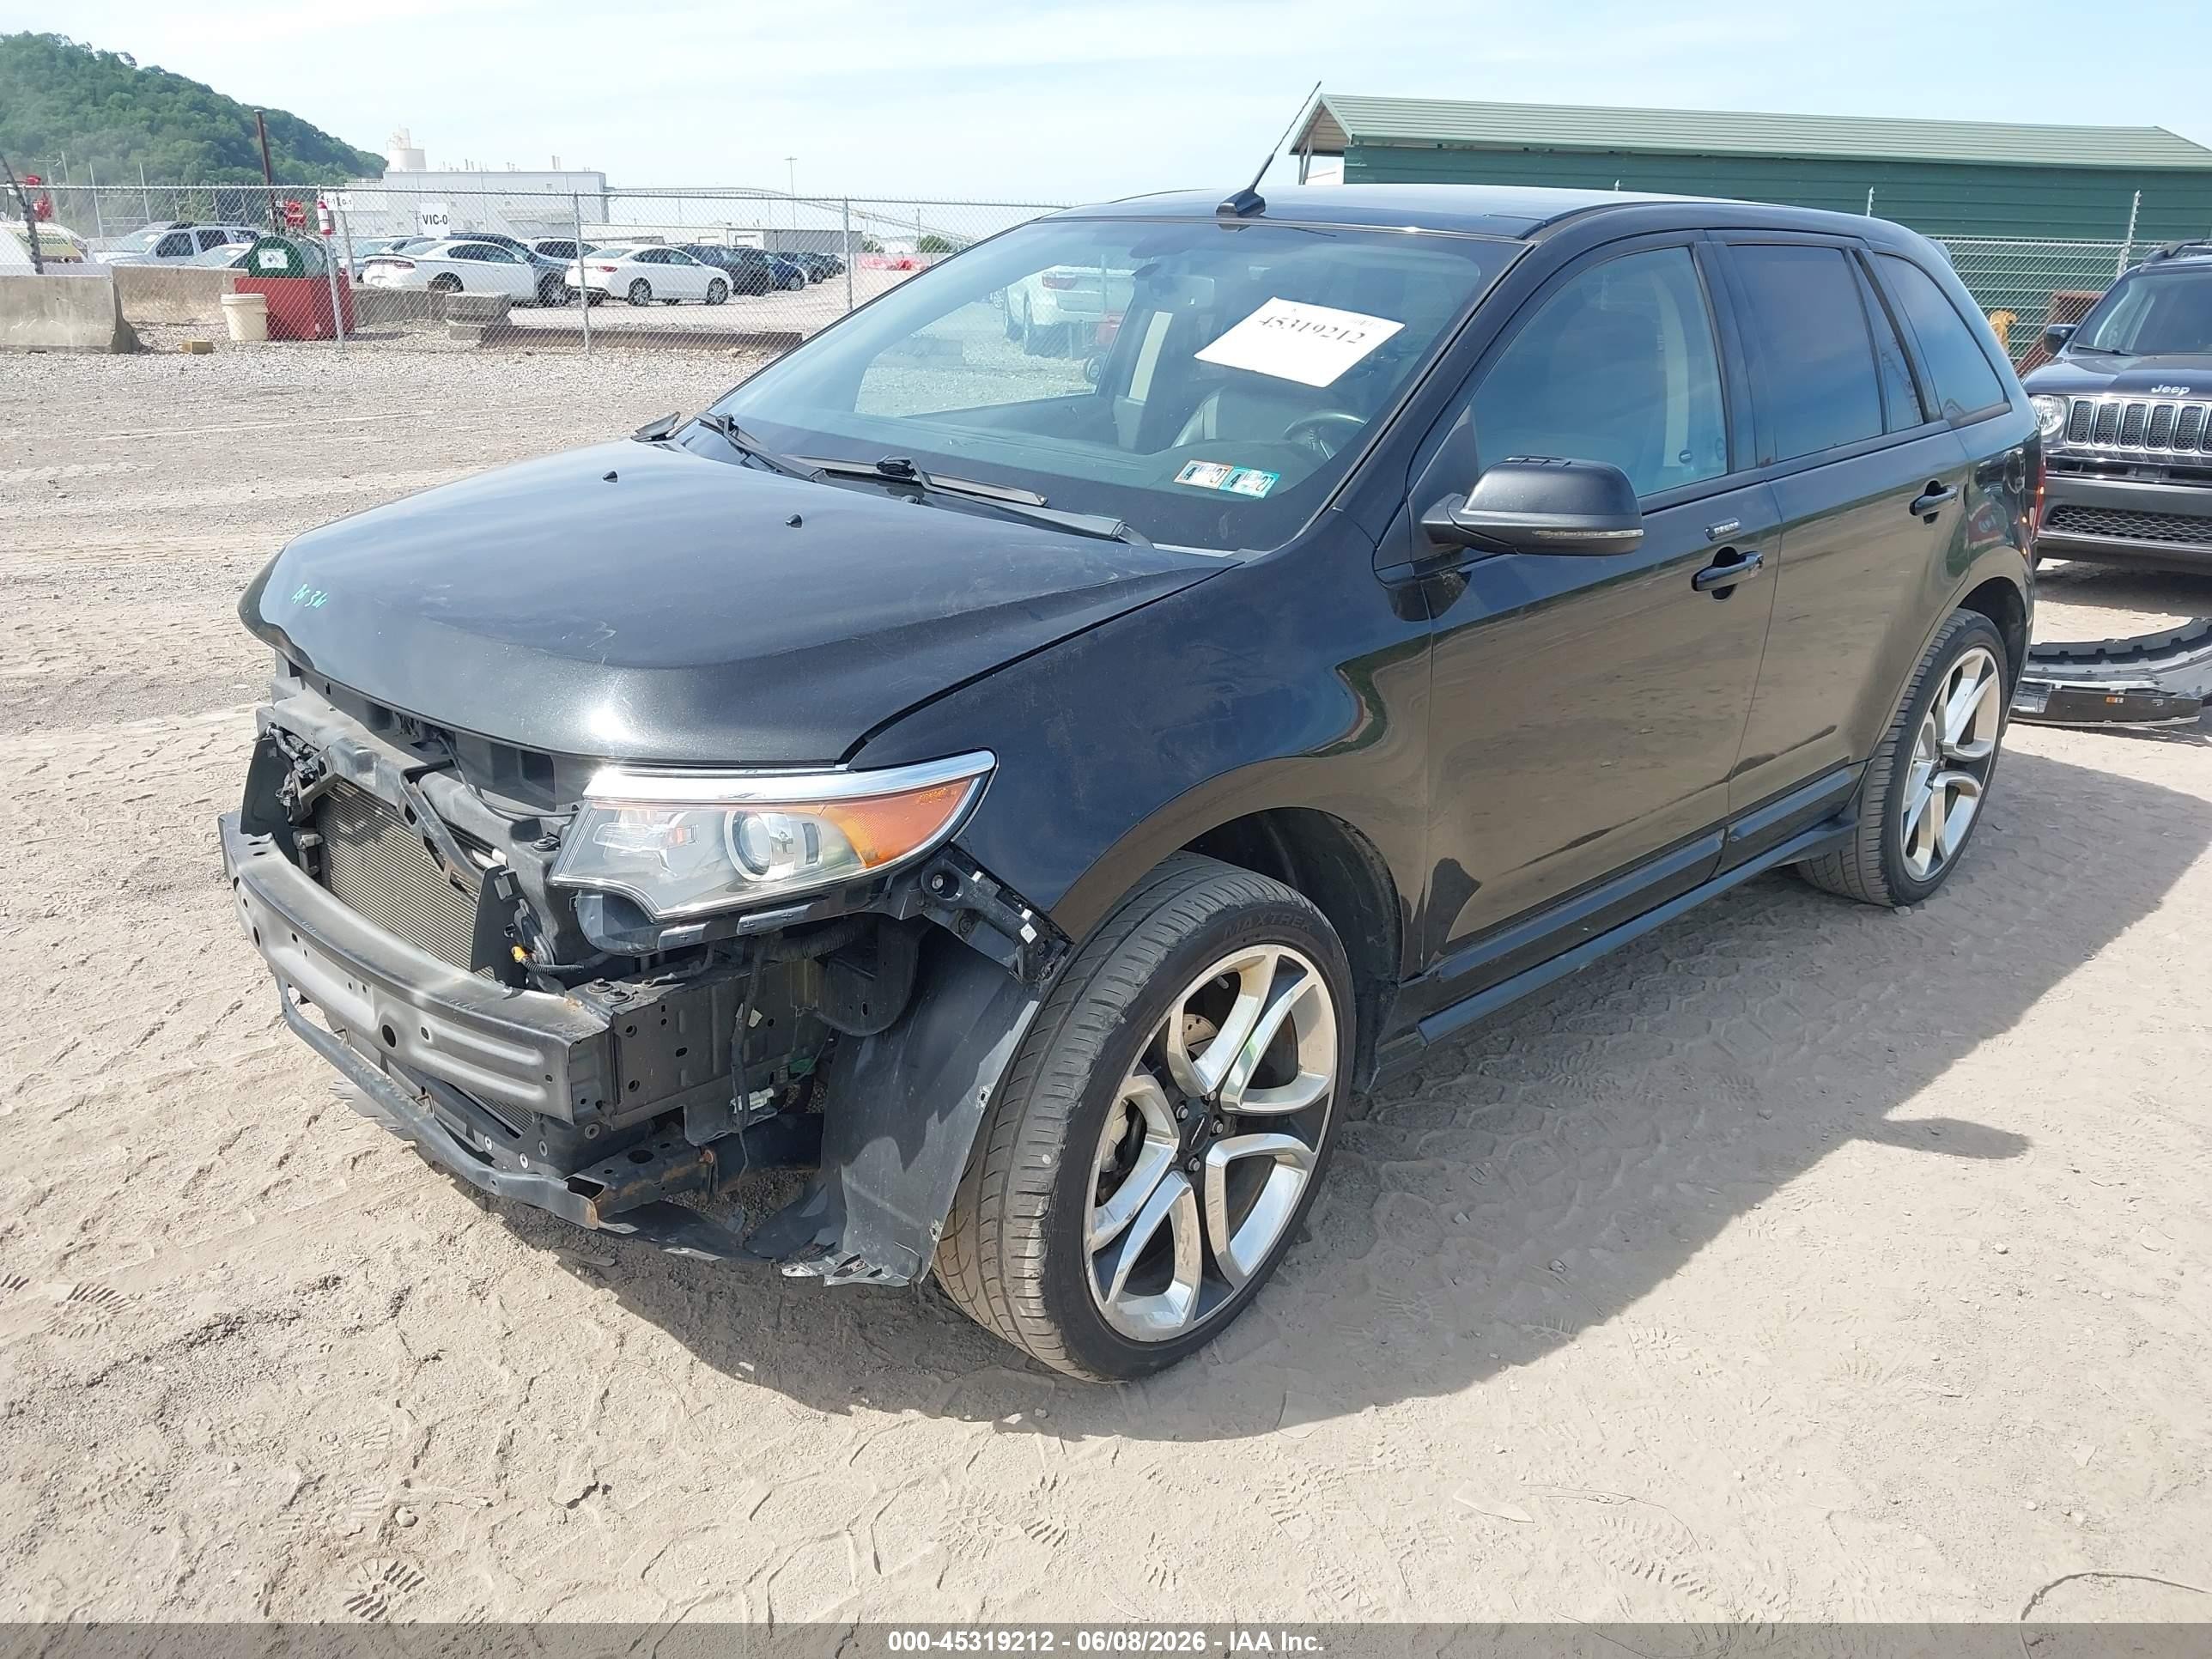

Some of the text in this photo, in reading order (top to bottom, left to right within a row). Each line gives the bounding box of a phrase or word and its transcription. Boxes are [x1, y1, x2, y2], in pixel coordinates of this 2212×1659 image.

[1258, 314, 1365, 344] 45319212
[2150, 384, 2191, 397] Jeep
[1229, 473, 1274, 493] 4 27
[1224, 911, 1314, 938] MAXTREK
